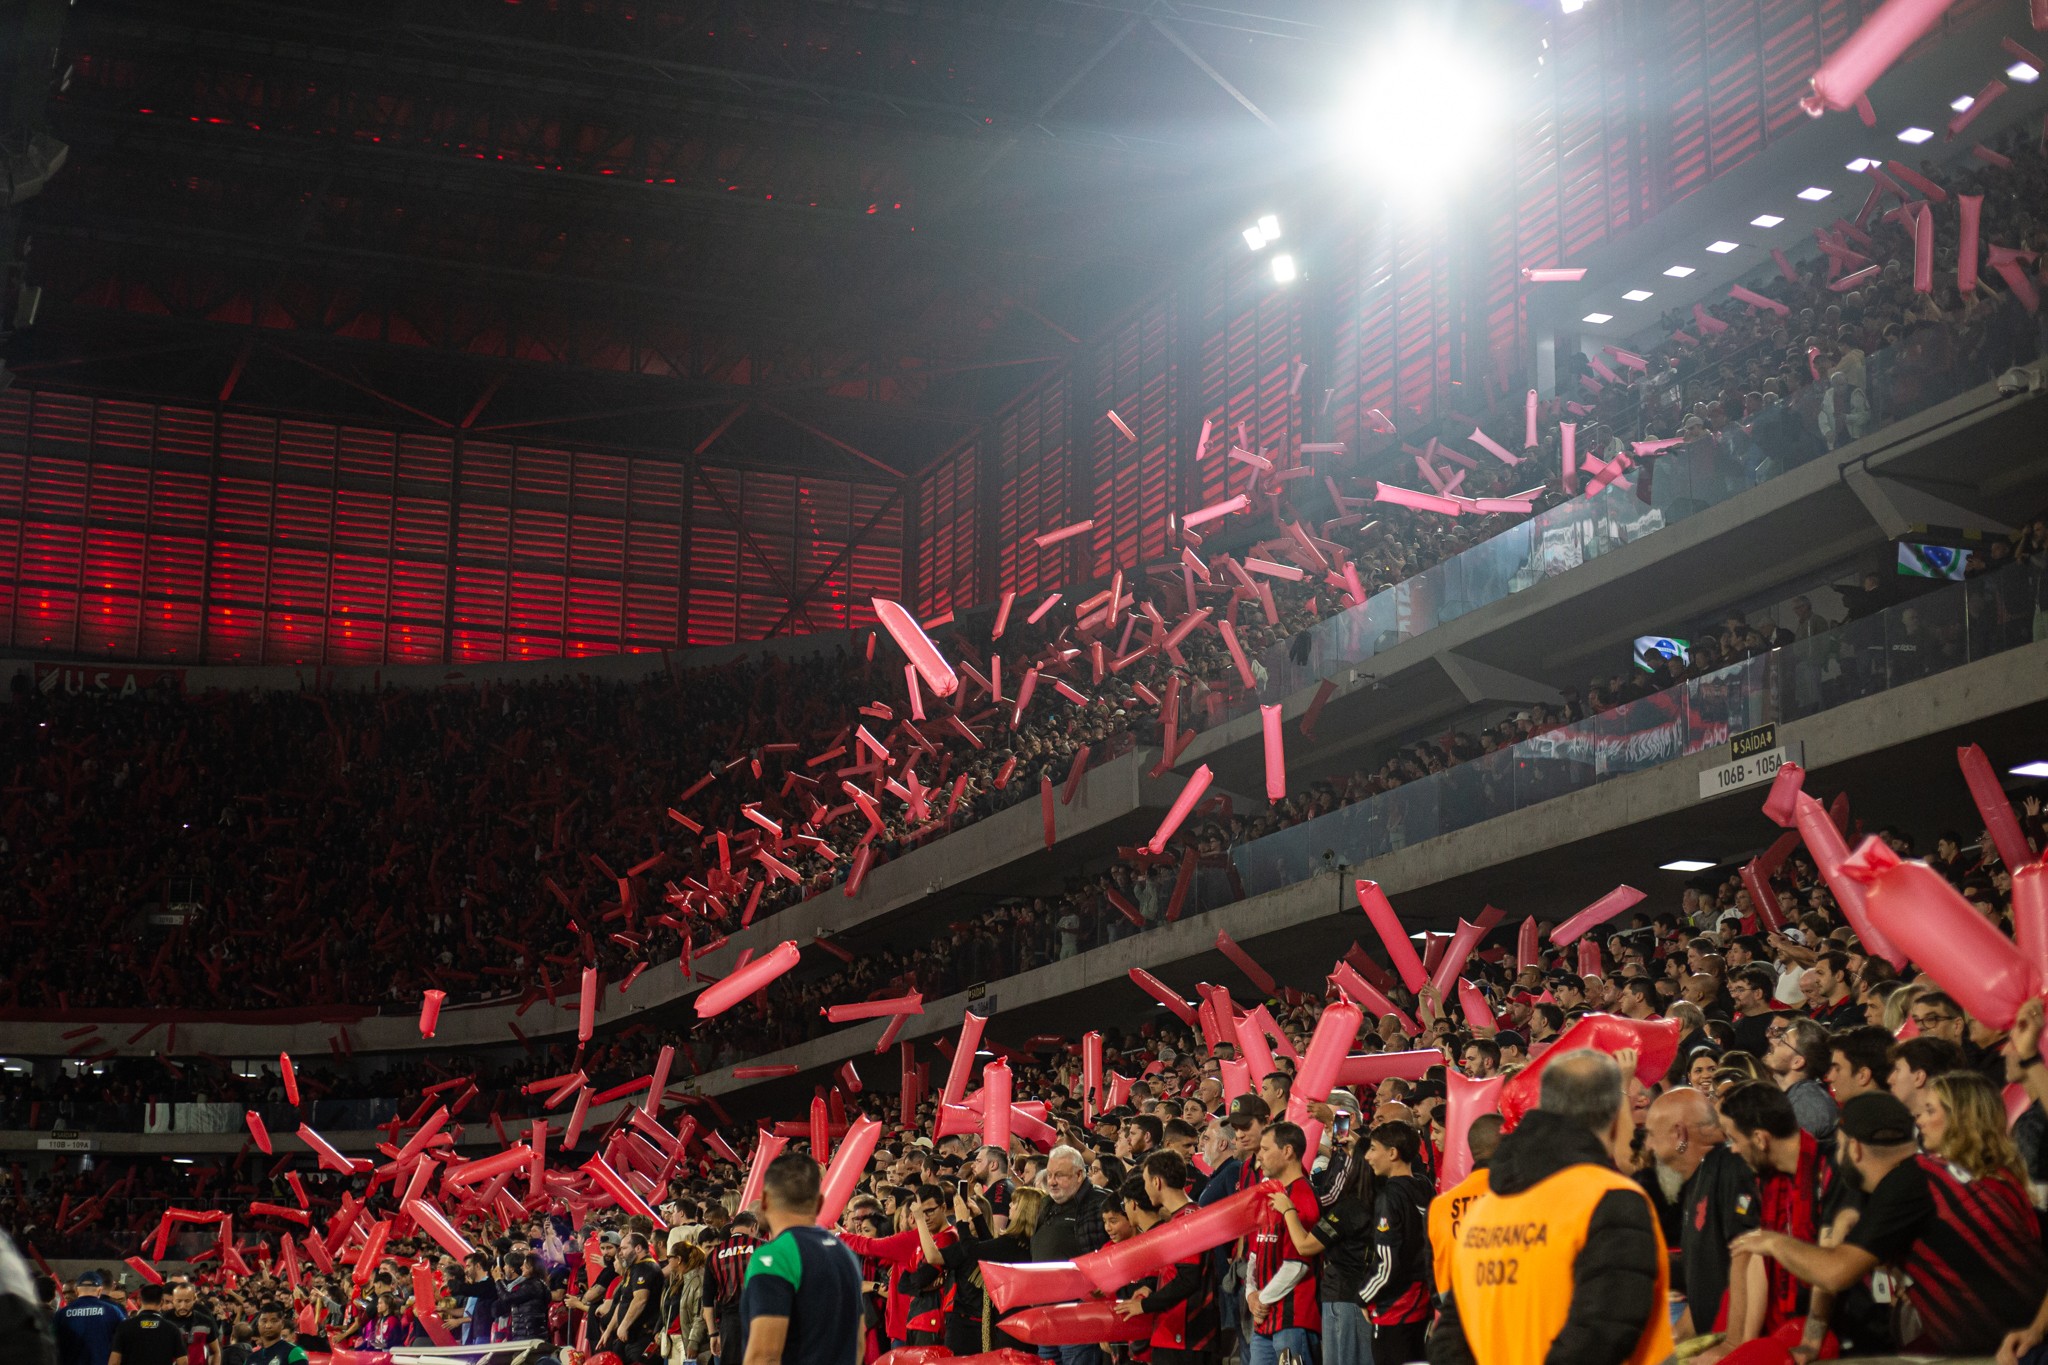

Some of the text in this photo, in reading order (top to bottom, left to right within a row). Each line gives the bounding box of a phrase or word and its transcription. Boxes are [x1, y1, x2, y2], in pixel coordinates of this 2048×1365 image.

[1740, 732, 1767, 754] SAÍDA
[1718, 765, 1745, 788] 106B
[1756, 753, 1783, 776] 105A
[49, 1141, 66, 1149] 110B
[73, 1141, 89, 1149] 109A
[718, 1245, 754, 1259] CAIXA
[66, 1307, 103, 1318] CORITIBA
